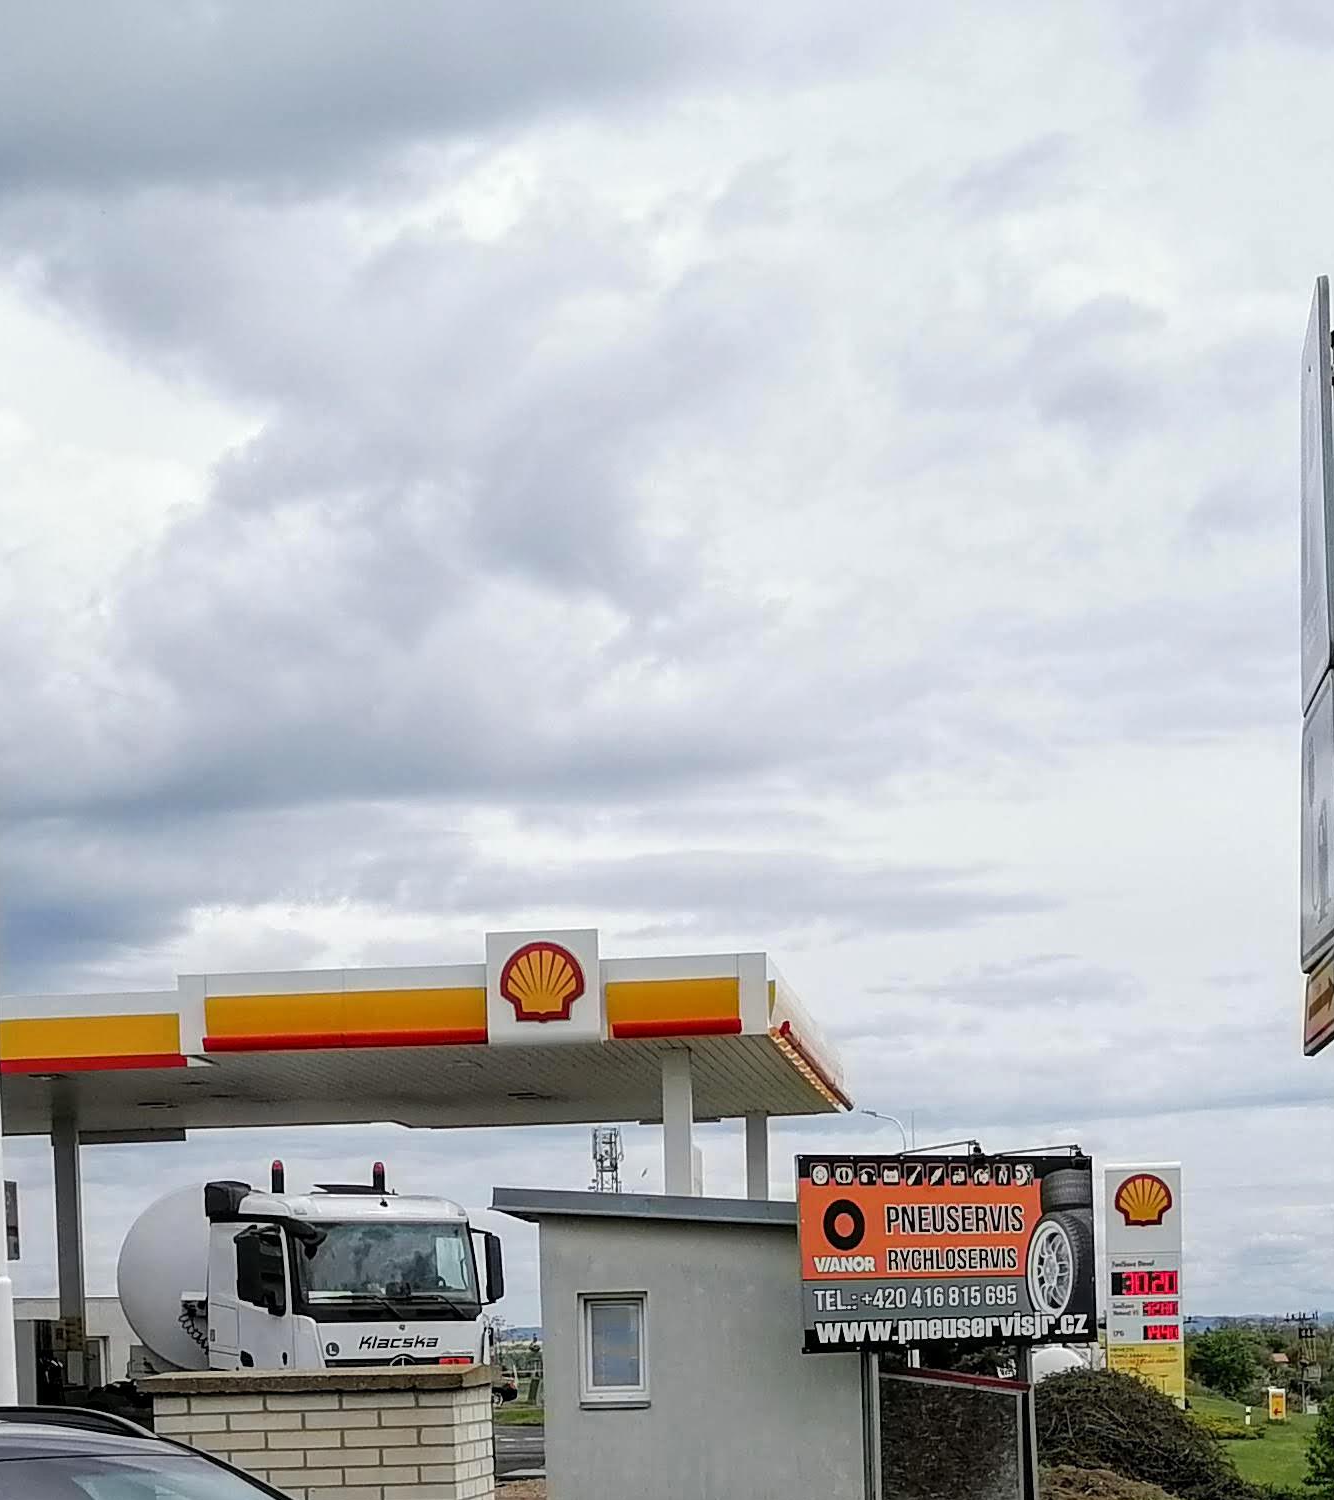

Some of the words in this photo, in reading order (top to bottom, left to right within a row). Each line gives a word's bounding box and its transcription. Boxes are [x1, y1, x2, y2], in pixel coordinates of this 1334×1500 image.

[885, 1205, 1025, 1235] PNEUSERVIS
[813, 1256, 876, 1273] VIANOR
[886, 1247, 1018, 1272] RYCHLOSERVIS
[814, 1289, 857, 1311] TEL.:
[861, 1287, 907, 1310] +420
[911, 1286, 944, 1308] 416
[949, 1285, 980, 1307] 815
[985, 1284, 1017, 1306] 695
[815, 1312, 1089, 1344] www.pneuservisjr.cz
[359, 1335, 439, 1350] Klacska
